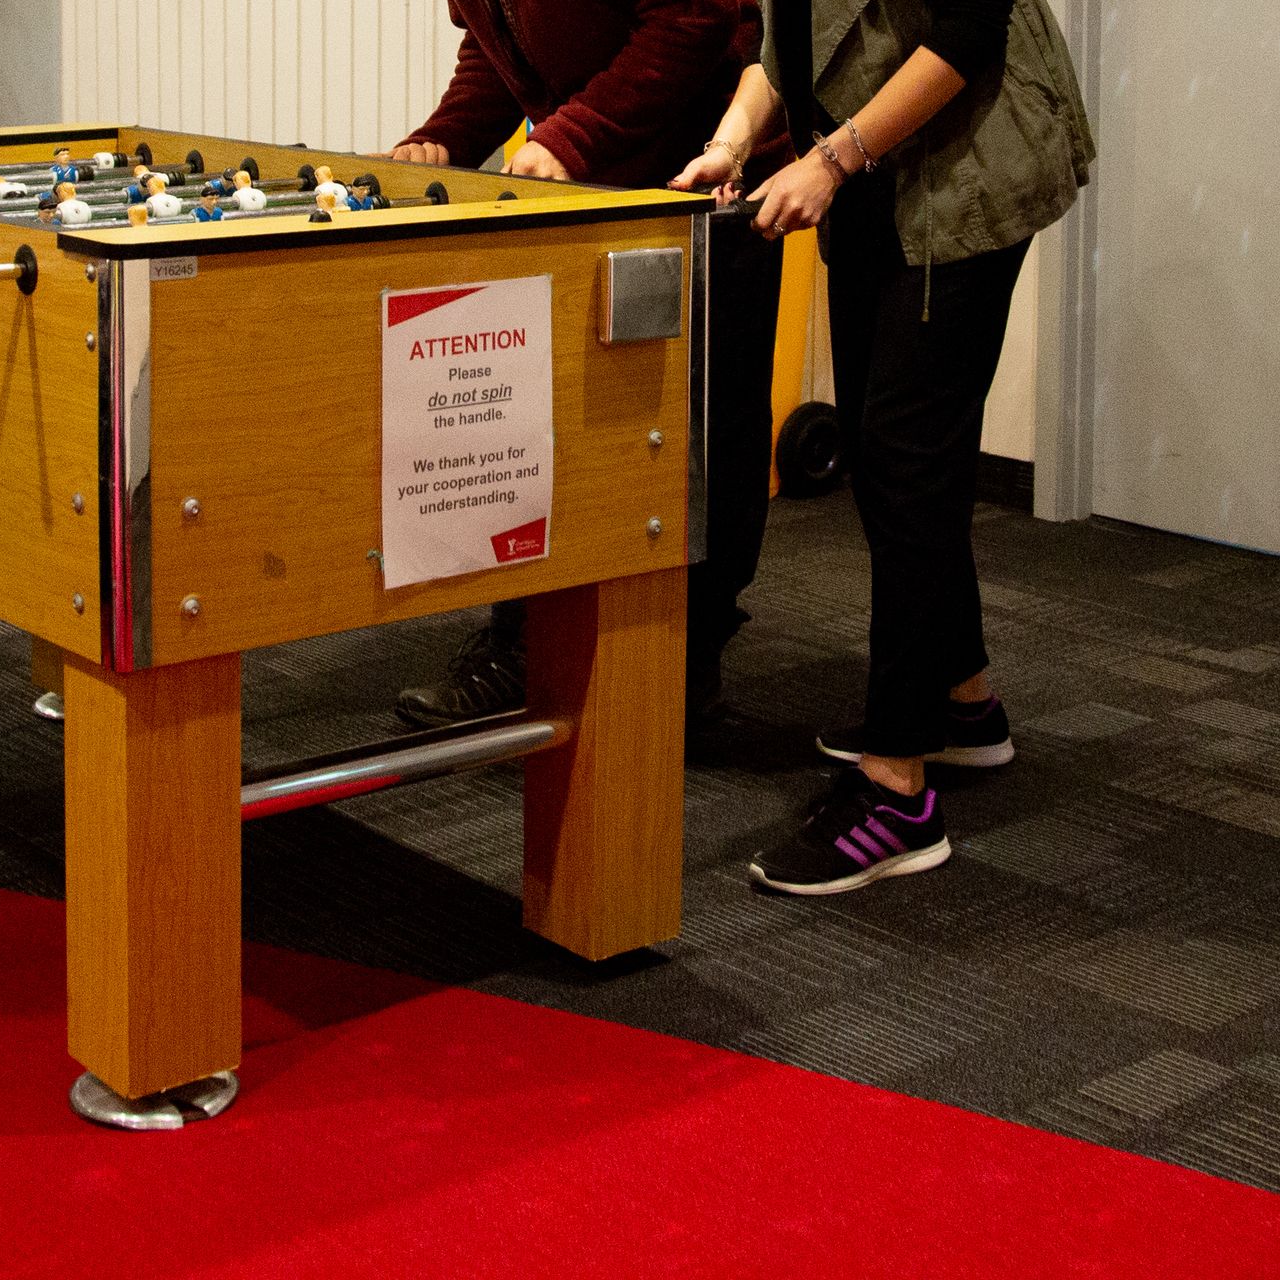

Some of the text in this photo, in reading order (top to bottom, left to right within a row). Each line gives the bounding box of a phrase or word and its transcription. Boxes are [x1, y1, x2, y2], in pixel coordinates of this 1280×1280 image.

[155, 264, 193, 276] Y16245
[409, 328, 527, 361] ATTENTION
[449, 367, 492, 381] Please
[427, 384, 512, 408] do not spin
[434, 408, 506, 429] the handle.
[413, 446, 526, 473] We thank you for
[398, 463, 539, 500] your cooperation and
[419, 490, 519, 515] understanding.
